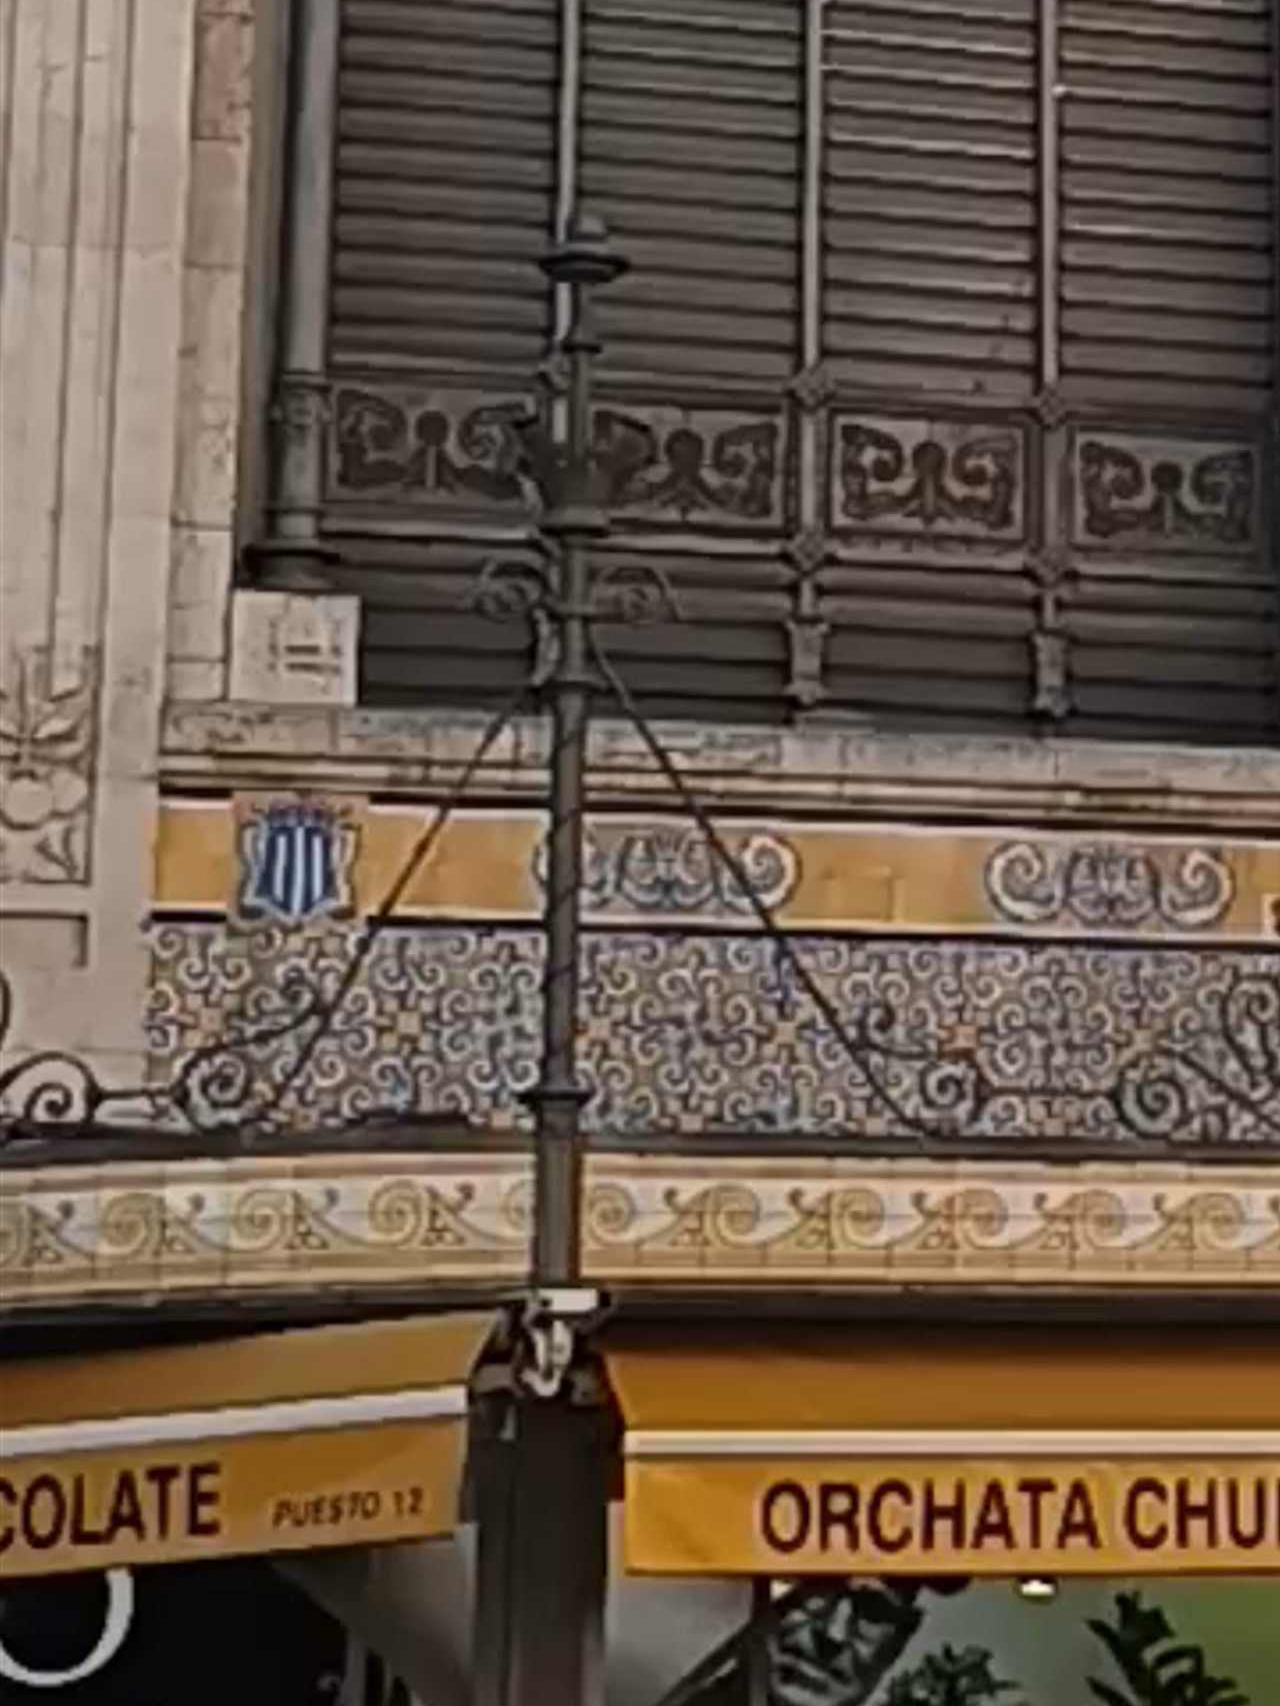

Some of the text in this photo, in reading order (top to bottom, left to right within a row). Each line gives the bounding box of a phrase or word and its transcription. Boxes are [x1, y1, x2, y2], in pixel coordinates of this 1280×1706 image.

[272, 1490, 382, 1529] PUESTO
[393, 1486, 424, 1518] 12
[760, 1477, 1103, 1553] ORCHATA
